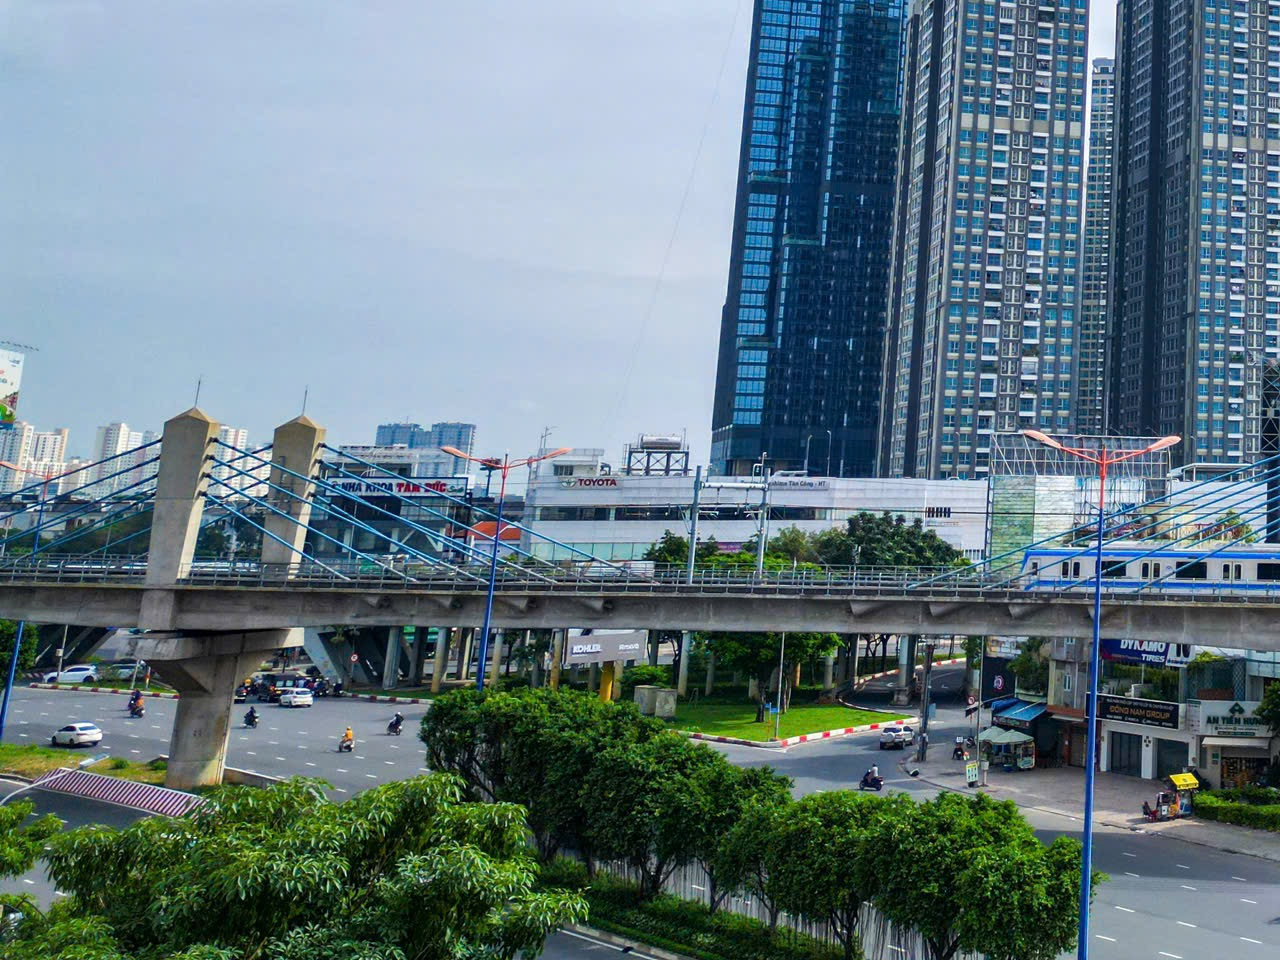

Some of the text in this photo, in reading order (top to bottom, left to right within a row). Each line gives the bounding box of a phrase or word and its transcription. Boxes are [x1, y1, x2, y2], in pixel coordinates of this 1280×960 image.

[365, 481, 394, 493] KHOA
[578, 478, 617, 486] TOYOTA
[572, 644, 602, 654] KOHLER
[1120, 640, 1166, 653] DYNAMO
[1141, 654, 1165, 663] TIRES
[1129, 708, 1146, 718] NAM
[1146, 710, 1171, 720] GROUP
[1207, 715, 1220, 725] AN
